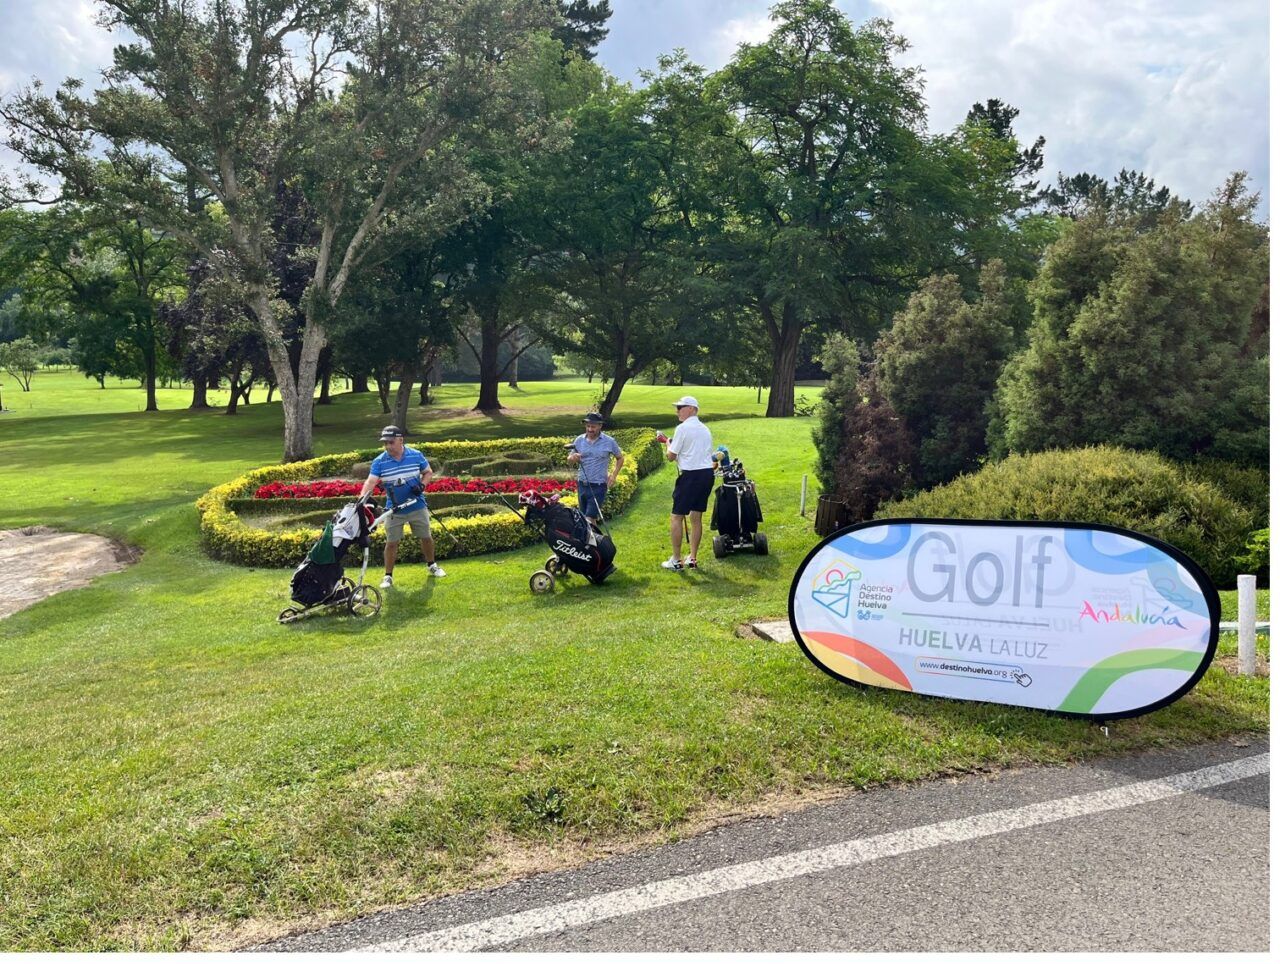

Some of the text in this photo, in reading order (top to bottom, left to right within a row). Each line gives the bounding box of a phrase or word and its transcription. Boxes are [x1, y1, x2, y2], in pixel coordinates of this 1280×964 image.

[553, 540, 593, 562] Titleist
[907, 531, 1053, 609] Golf
[859, 591, 892, 602] Destino
[860, 583, 893, 593] Agencia
[858, 600, 887, 609] Huelva
[1080, 600, 1188, 630] Andalucía
[898, 627, 983, 653] HUELVA
[919, 660, 1008, 678] www.destinohuelva.org
